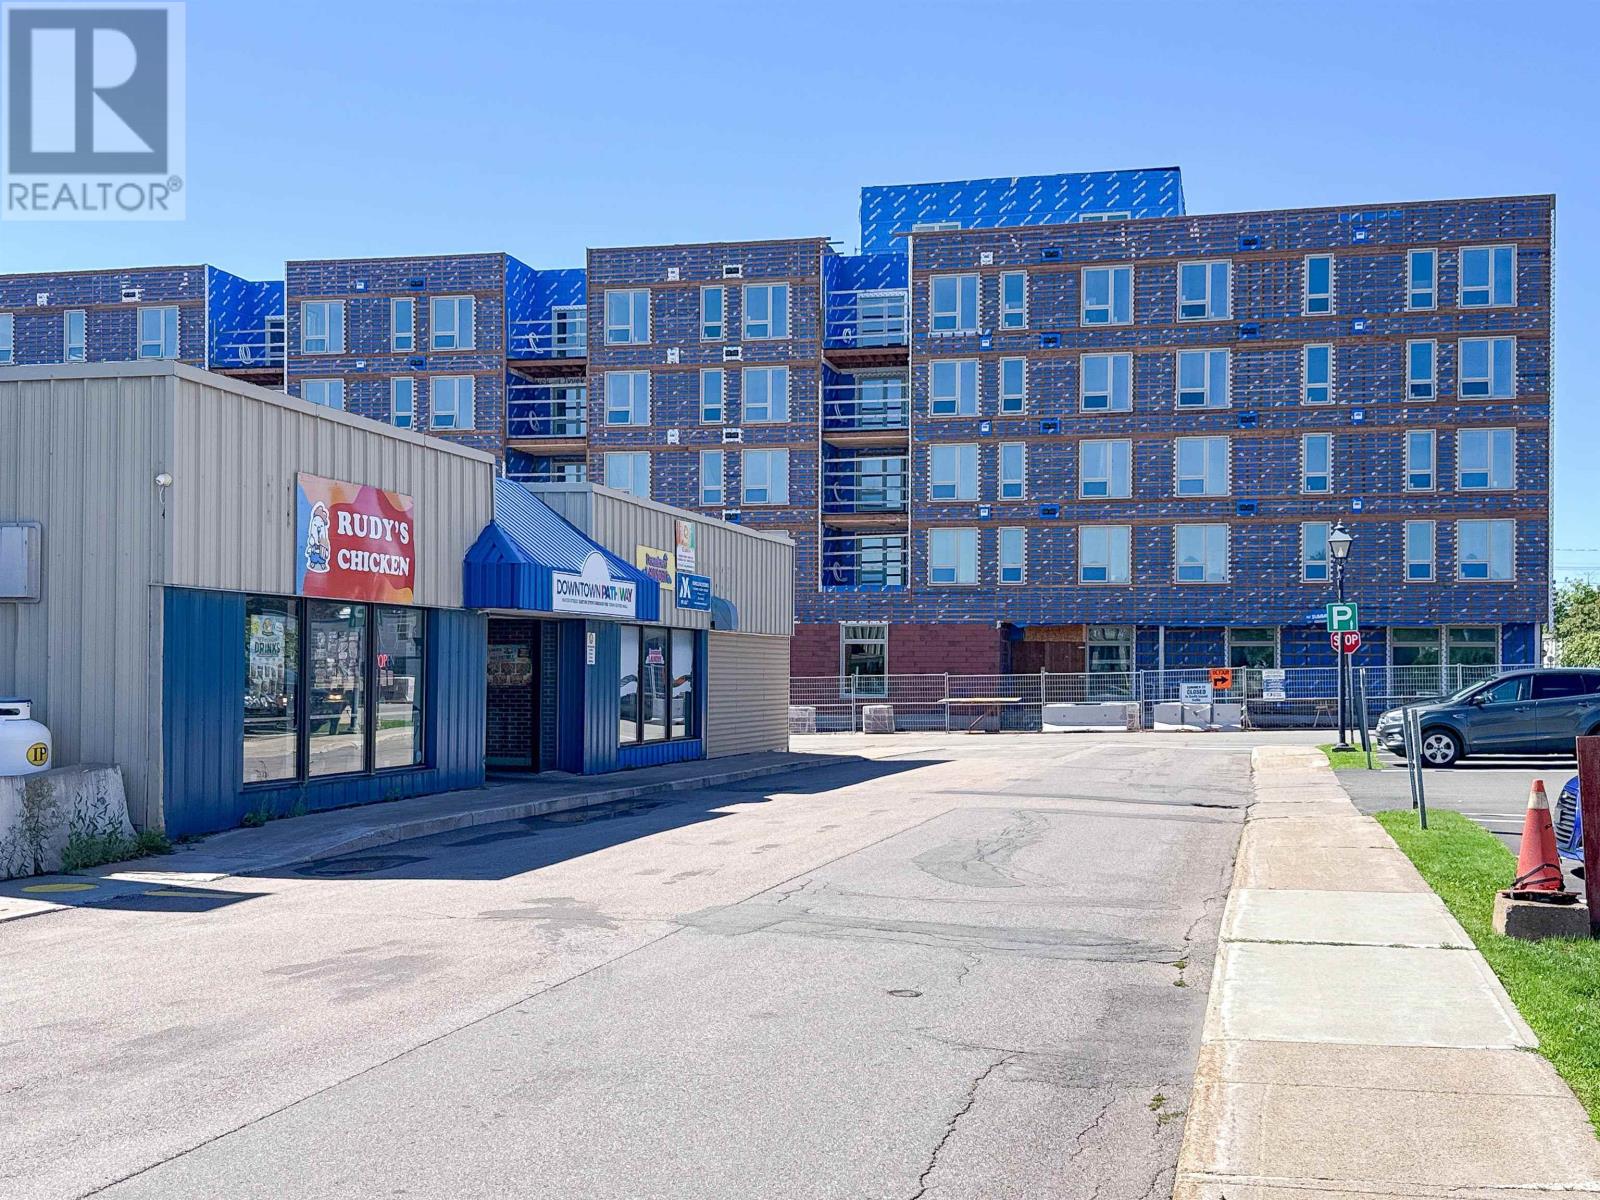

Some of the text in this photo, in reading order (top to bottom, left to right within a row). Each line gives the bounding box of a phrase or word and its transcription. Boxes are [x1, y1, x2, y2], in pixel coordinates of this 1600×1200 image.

[337, 510, 410, 545] RUDY'S
[337, 548, 410, 577] CHICKEN
[1332, 605, 1353, 630] P
[254, 641, 281, 654] DRINKS
[1333, 634, 1359, 646] SOP
[32, 747, 47, 761] IP
